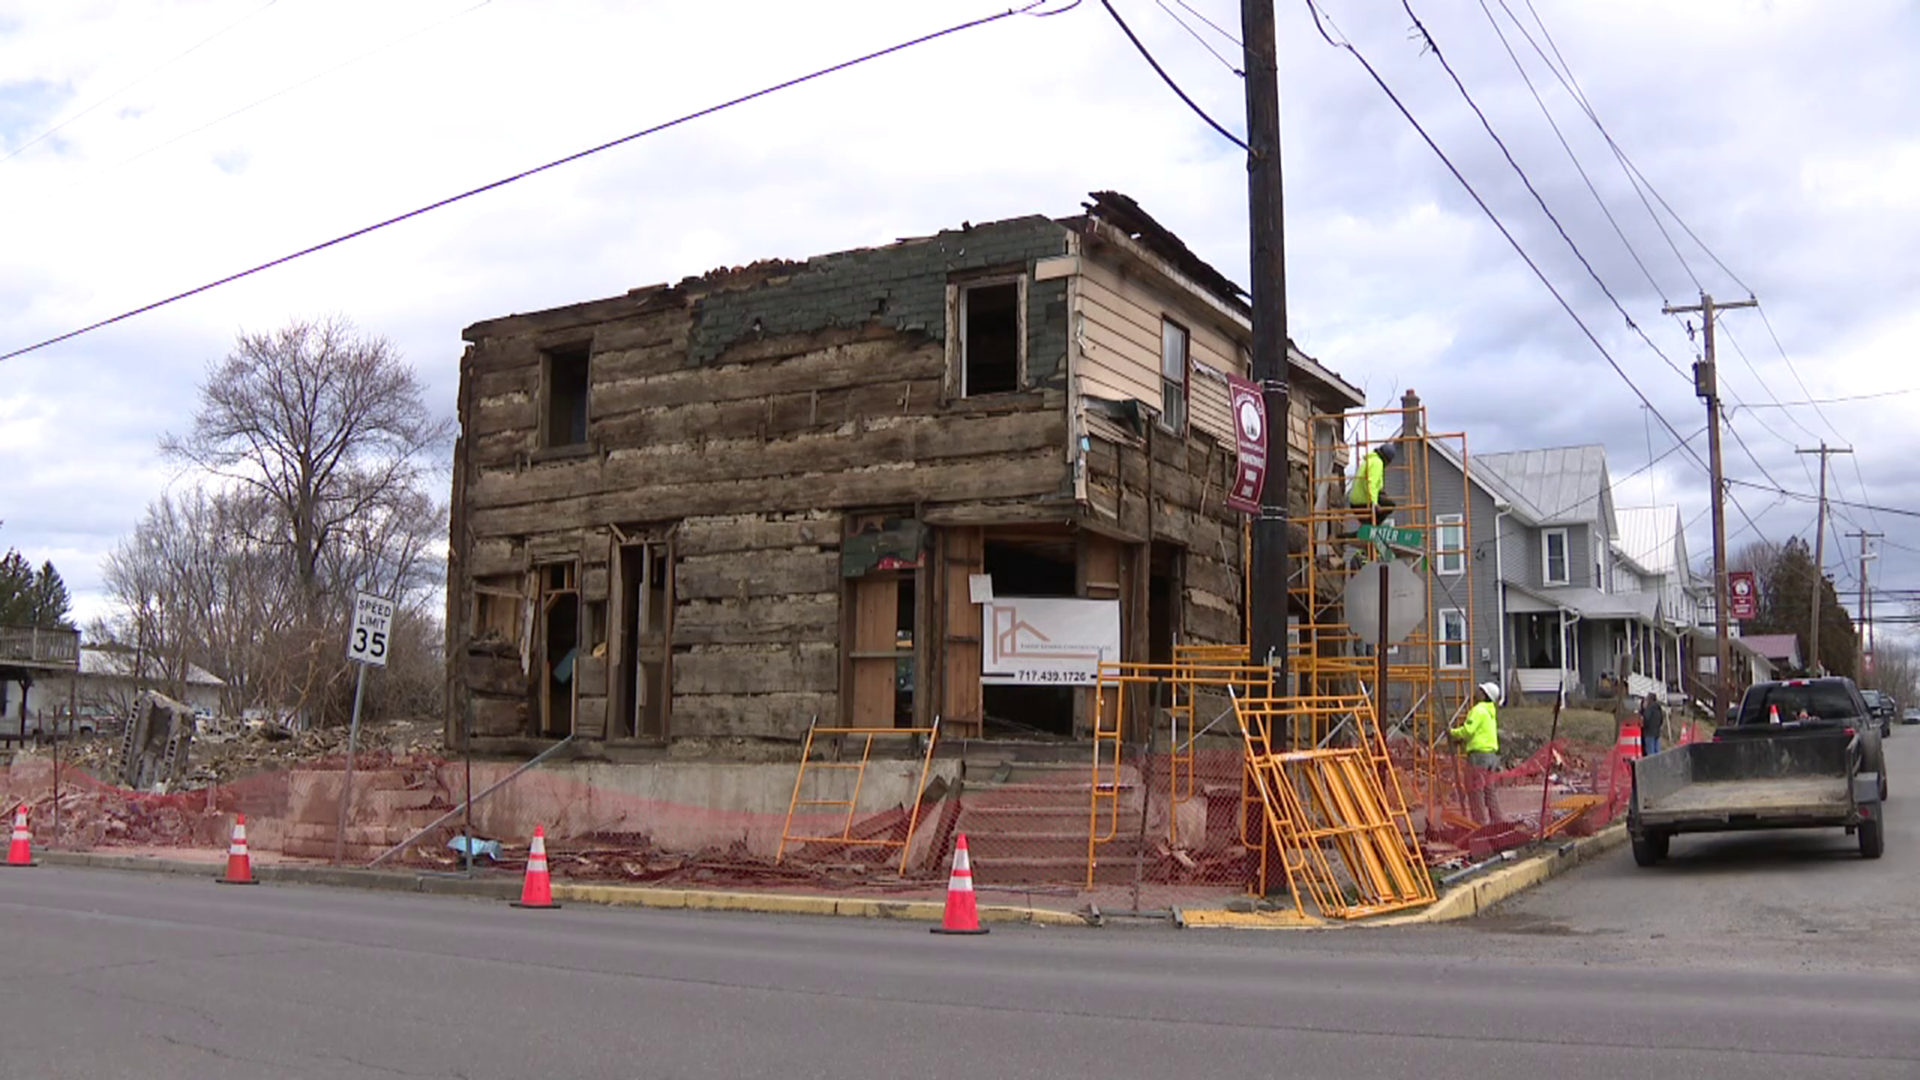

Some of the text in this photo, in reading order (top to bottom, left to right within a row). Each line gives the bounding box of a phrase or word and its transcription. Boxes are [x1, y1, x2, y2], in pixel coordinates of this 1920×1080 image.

[1369, 526, 1399, 542] WATER
[359, 600, 391, 617] SPEED
[359, 614, 386, 630] LIMIT
[353, 627, 386, 657] 35
[1018, 669, 1087, 682] 717.439.1726
